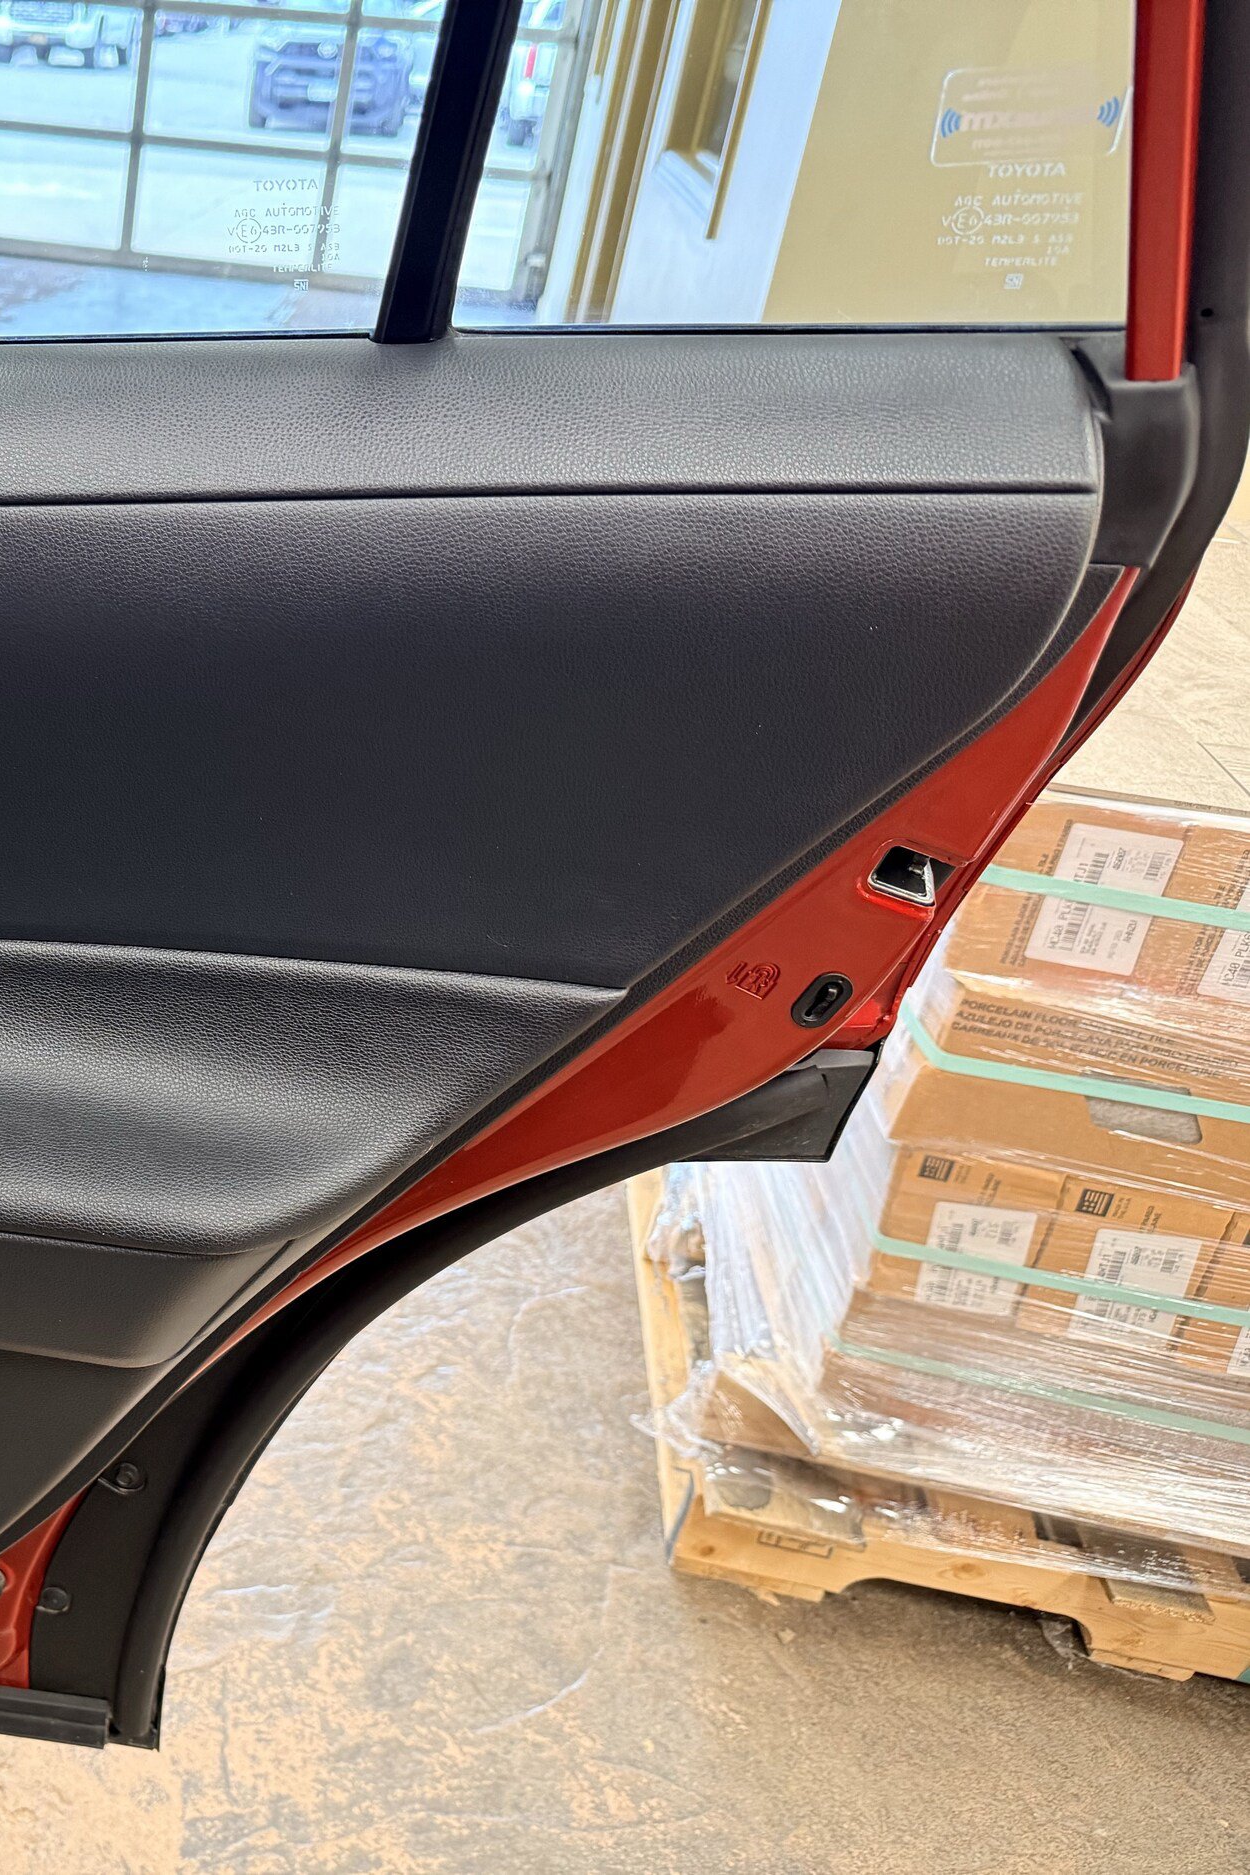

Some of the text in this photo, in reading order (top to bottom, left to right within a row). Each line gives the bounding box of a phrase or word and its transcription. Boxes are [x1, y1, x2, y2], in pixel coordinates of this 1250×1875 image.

[989, 162, 1066, 177] TOYOTA
[253, 178, 318, 191] TOYOTA
[992, 191, 1083, 206] AUTOMOTIVE
[234, 205, 340, 218] AGC AUTOMOTIVE
[273, 244, 300, 252] M2L3
[293, 279, 309, 292] SNI
[960, 999, 1033, 1020] PORCELAIN
[1034, 1012, 1080, 1028] FLOOR
[956, 1010, 1013, 1029] AZULEJO
[1014, 1021, 1032, 1032] DE
